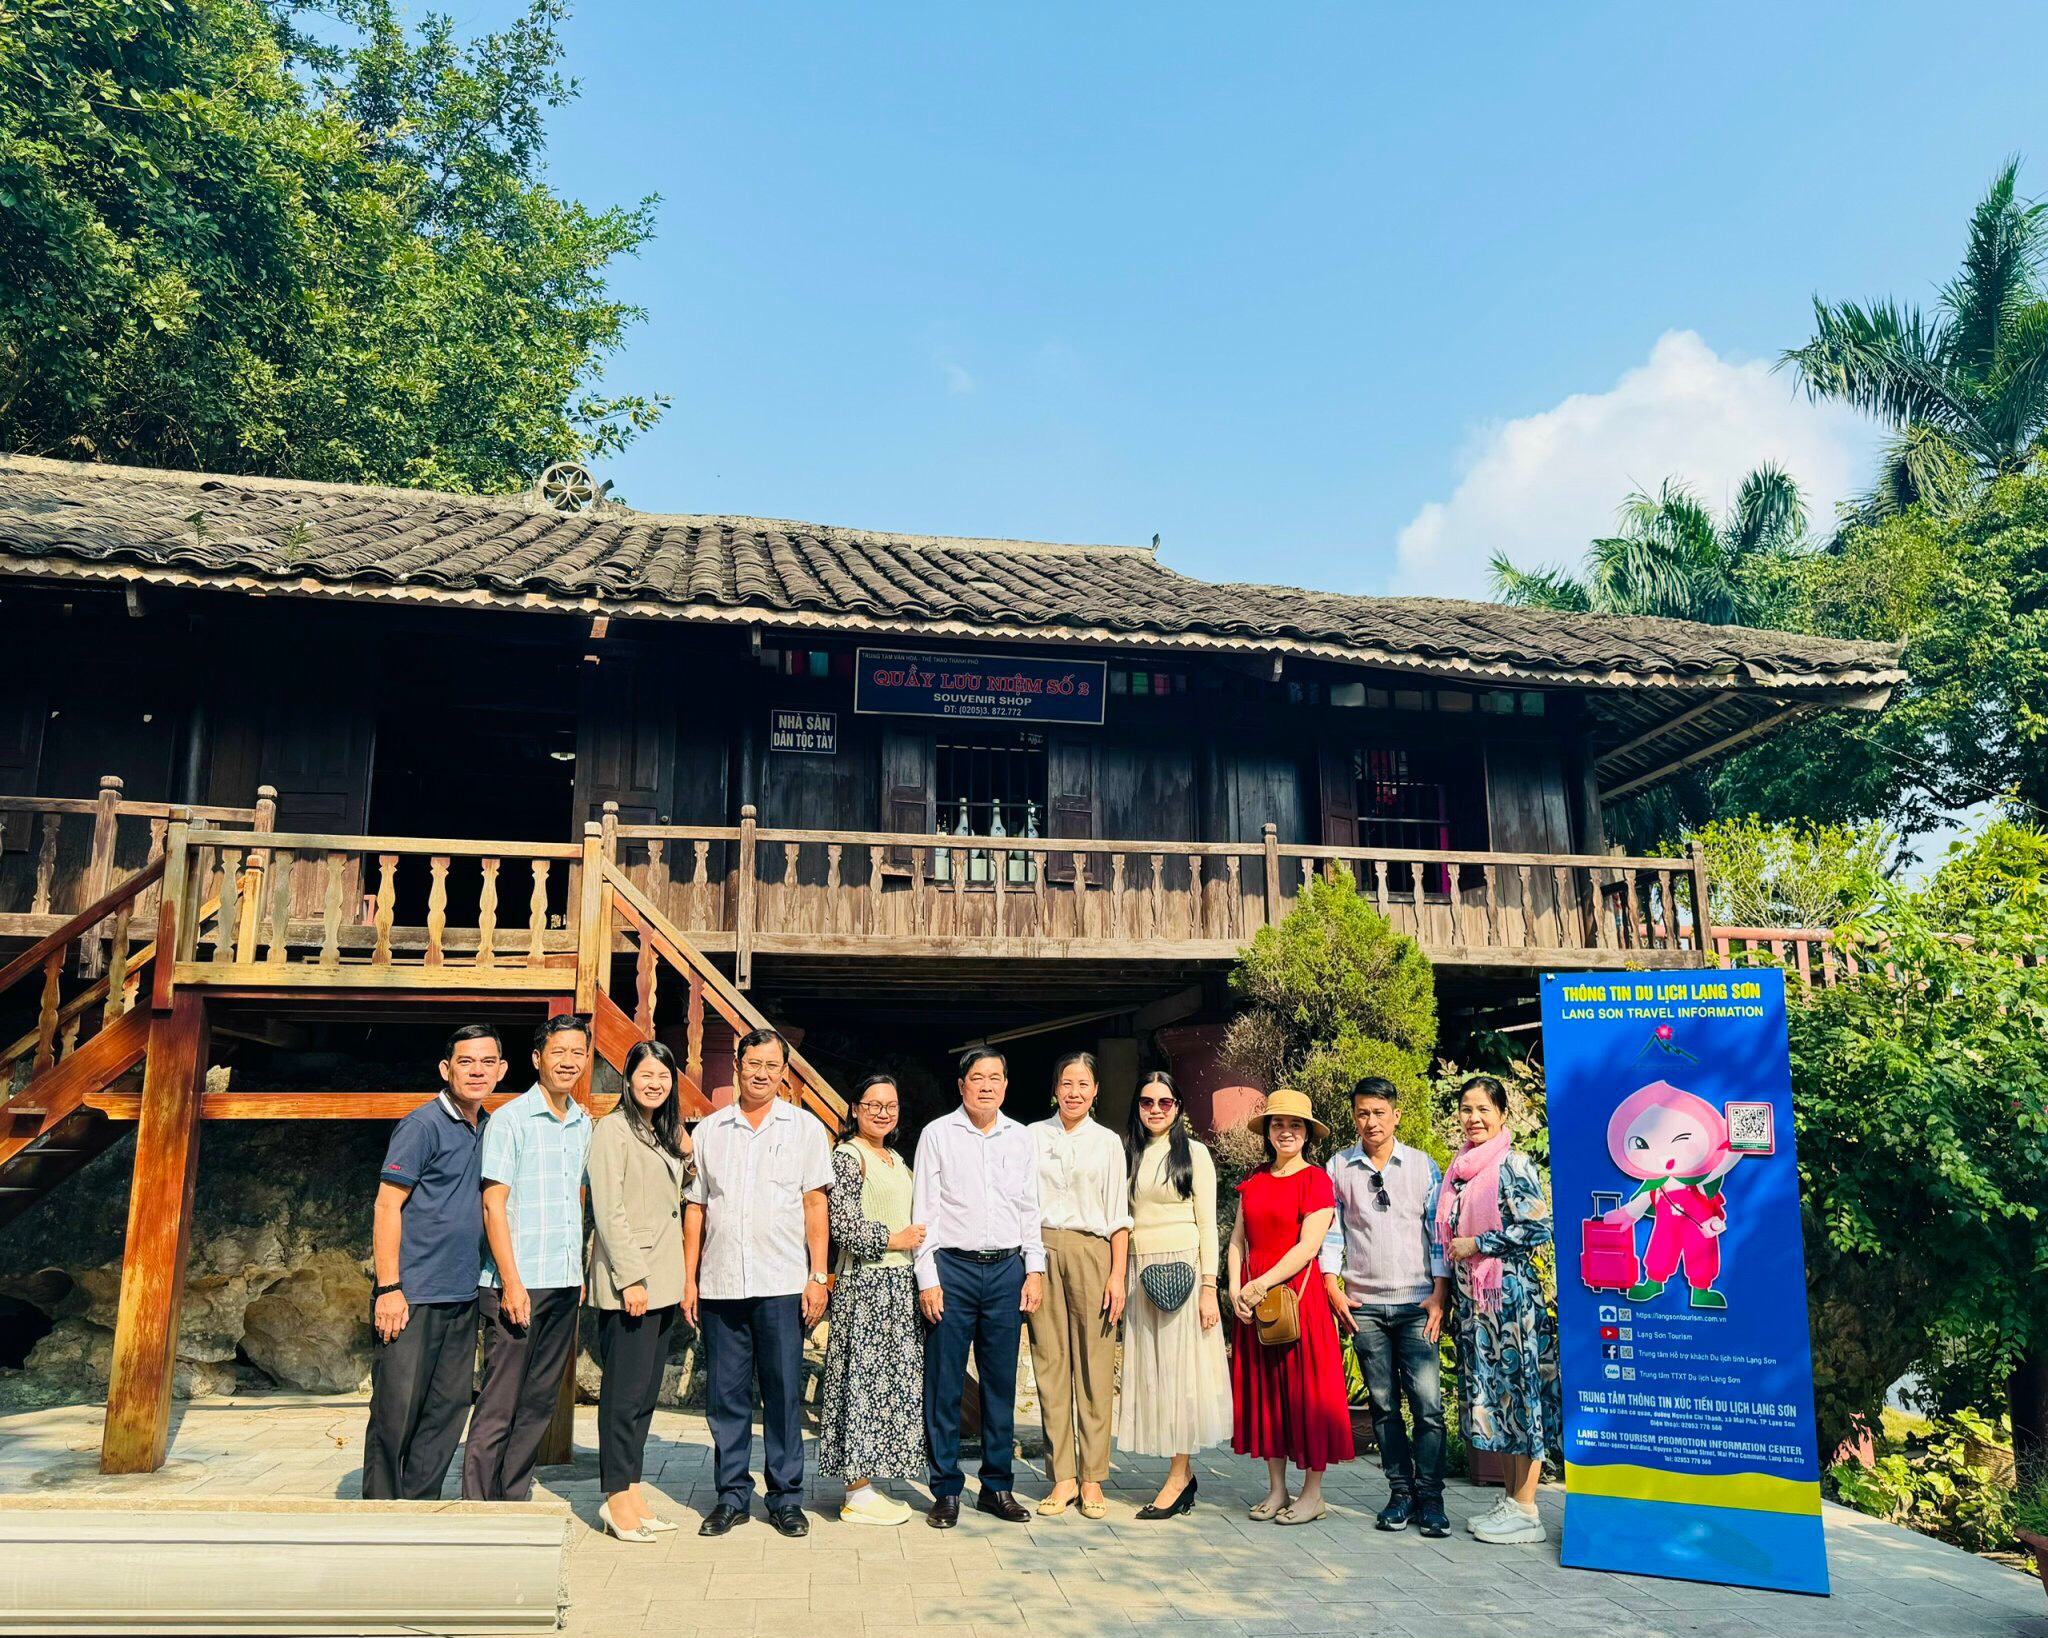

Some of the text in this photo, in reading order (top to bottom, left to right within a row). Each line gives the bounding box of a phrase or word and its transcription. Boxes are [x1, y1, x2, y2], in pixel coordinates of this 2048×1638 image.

[940, 672, 982, 690] LƯU
[986, 673, 1043, 696] NIỆM
[1046, 674, 1075, 695] SỐ
[1078, 682, 1089, 695] 2
[933, 693, 1032, 706] SOUVENIR SHOP
[944, 705, 957, 713] ĐT:
[991, 707, 1022, 716] 872.772
[778, 712, 831, 731] NHÀ SÀN
[773, 730, 833, 750] DÂN TỘC TÀY
[1562, 981, 1761, 1004] THÔNG TIN DU LỊCH LẠNG SƠN
[1562, 1006, 1764, 1020] LANG SON TRAVEL INFORMATION
[1637, 1331, 1693, 1341] Lạng Sơn Tourism
[1638, 1350, 1656, 1359] Trung
[1690, 1353, 1709, 1361] khách
[1746, 1356, 1762, 1365] Lạng
[1763, 1357, 1777, 1365] Sơn
[1640, 1371, 1657, 1380] Trung
[1710, 1376, 1727, 1385] Lạng
[1727, 1376, 1741, 1384] Sơn
[1578, 1391, 1797, 1418] TRUNG TÂM THÔNG TIN XÚC TIẾN DU LỊCH LẠNG SƠN
[1577, 1429, 1802, 1456] LANG SON TOURISM PROMOTION INFORMATION CENTER
[1768, 1455, 1782, 1463] Lang
[1794, 1457, 1805, 1465] City
